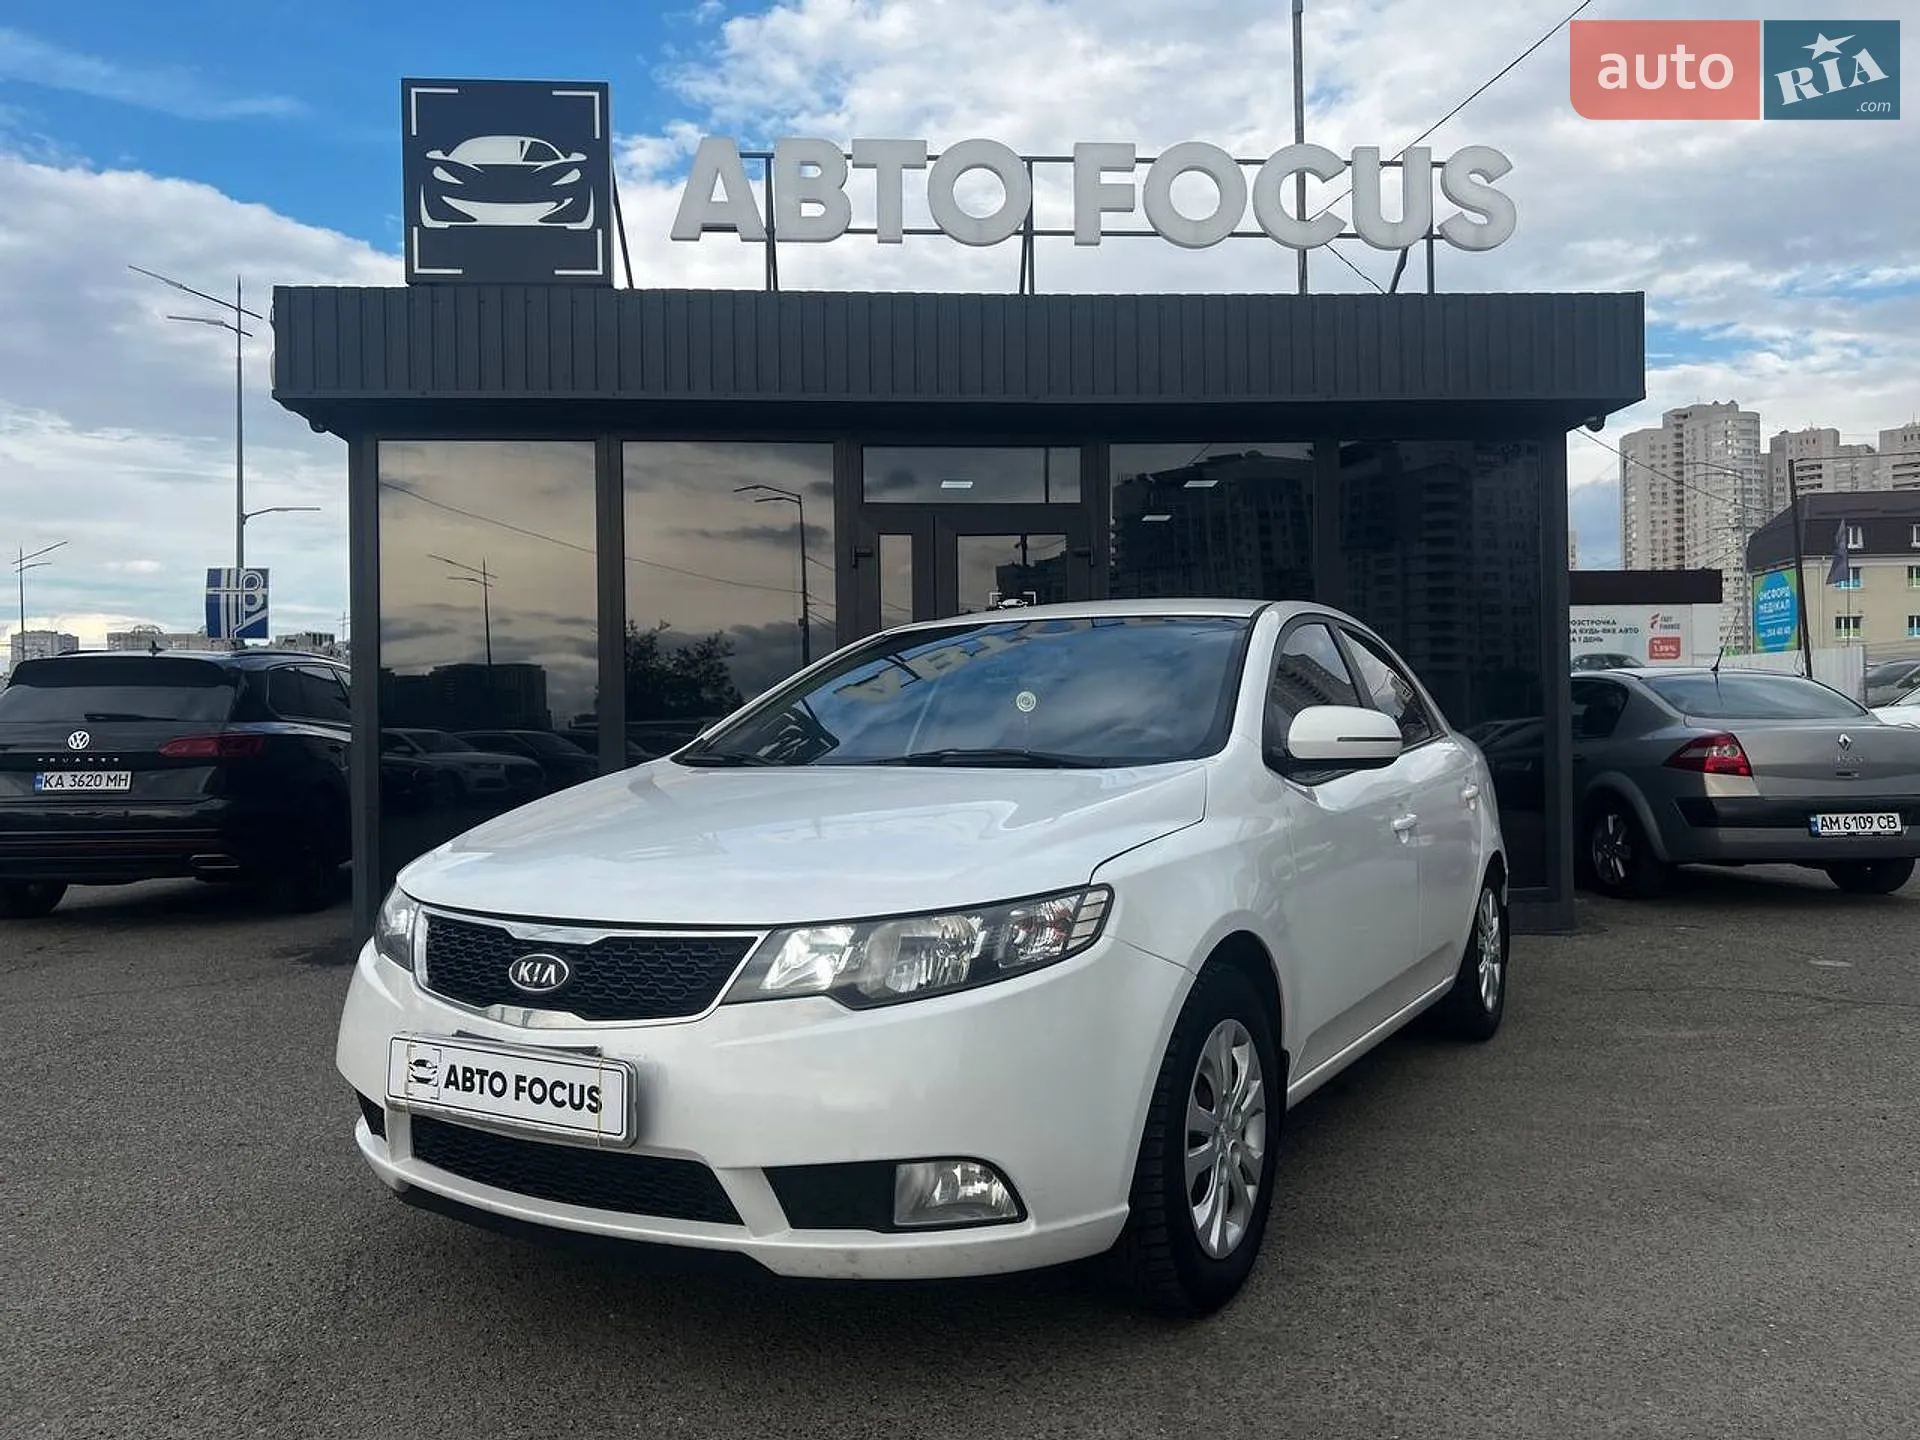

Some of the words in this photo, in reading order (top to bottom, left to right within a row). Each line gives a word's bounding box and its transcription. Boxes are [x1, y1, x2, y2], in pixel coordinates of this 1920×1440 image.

[671, 137, 1031, 246] АВТО
[1073, 141, 1517, 252] FOCUS
[43, 774, 64, 788] KA
[69, 774, 103, 788] 3620
[106, 774, 129, 788] MH
[1821, 816, 1841, 831] AM
[1843, 816, 1874, 830] 6109
[1877, 815, 1898, 830] CB
[517, 961, 556, 985] KIA
[443, 1063, 508, 1098] АВТО
[514, 1074, 603, 1114] FOCUS
